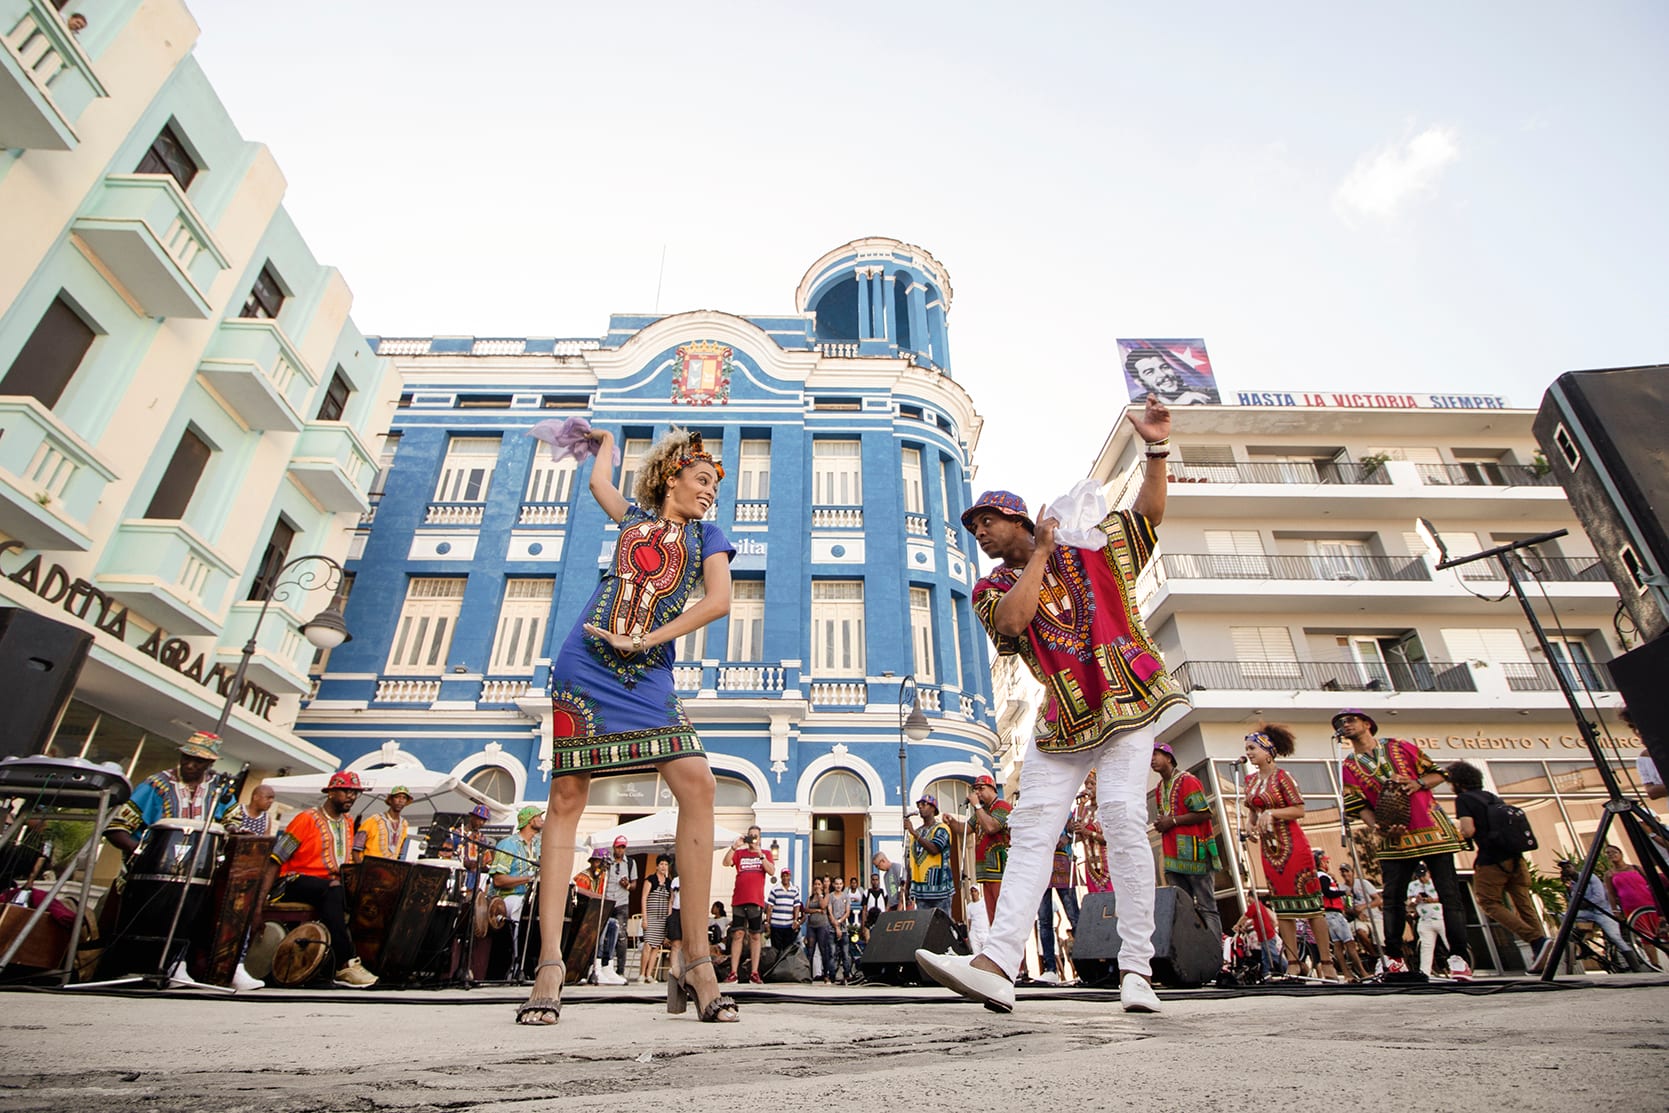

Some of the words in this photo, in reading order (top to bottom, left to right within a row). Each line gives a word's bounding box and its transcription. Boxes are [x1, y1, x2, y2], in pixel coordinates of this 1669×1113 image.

[1237, 392, 1296, 407] HASTA
[1303, 393, 1327, 408] LA
[1332, 394, 1418, 408] VICTORIA
[1429, 395, 1505, 409] SIEMPRE
[0, 540, 128, 642] CADENA
[136, 627, 280, 723] AGRAMONTE
[1538, 736, 1551, 750] Y
[885, 919, 916, 932] LEM
